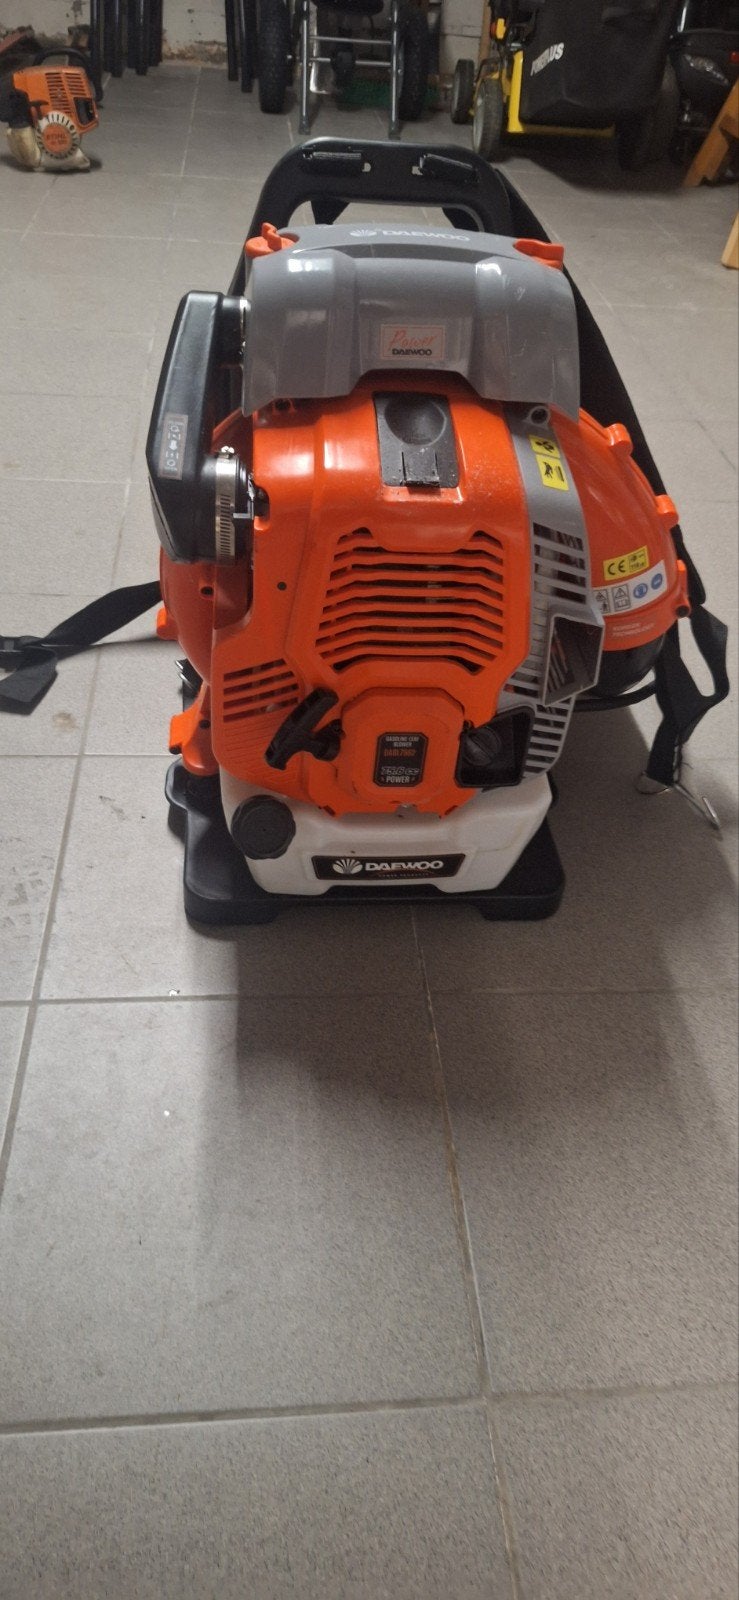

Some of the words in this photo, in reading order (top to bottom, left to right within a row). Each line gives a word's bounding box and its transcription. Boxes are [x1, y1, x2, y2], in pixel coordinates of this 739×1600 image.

[382, 230, 471, 242] DAEWOO
[386, 329, 440, 351] Power
[391, 347, 433, 356] DAEWOO
[607, 558, 626, 576] CE
[386, 776, 410, 784] POWER
[365, 860, 444, 871] DAEWOO
